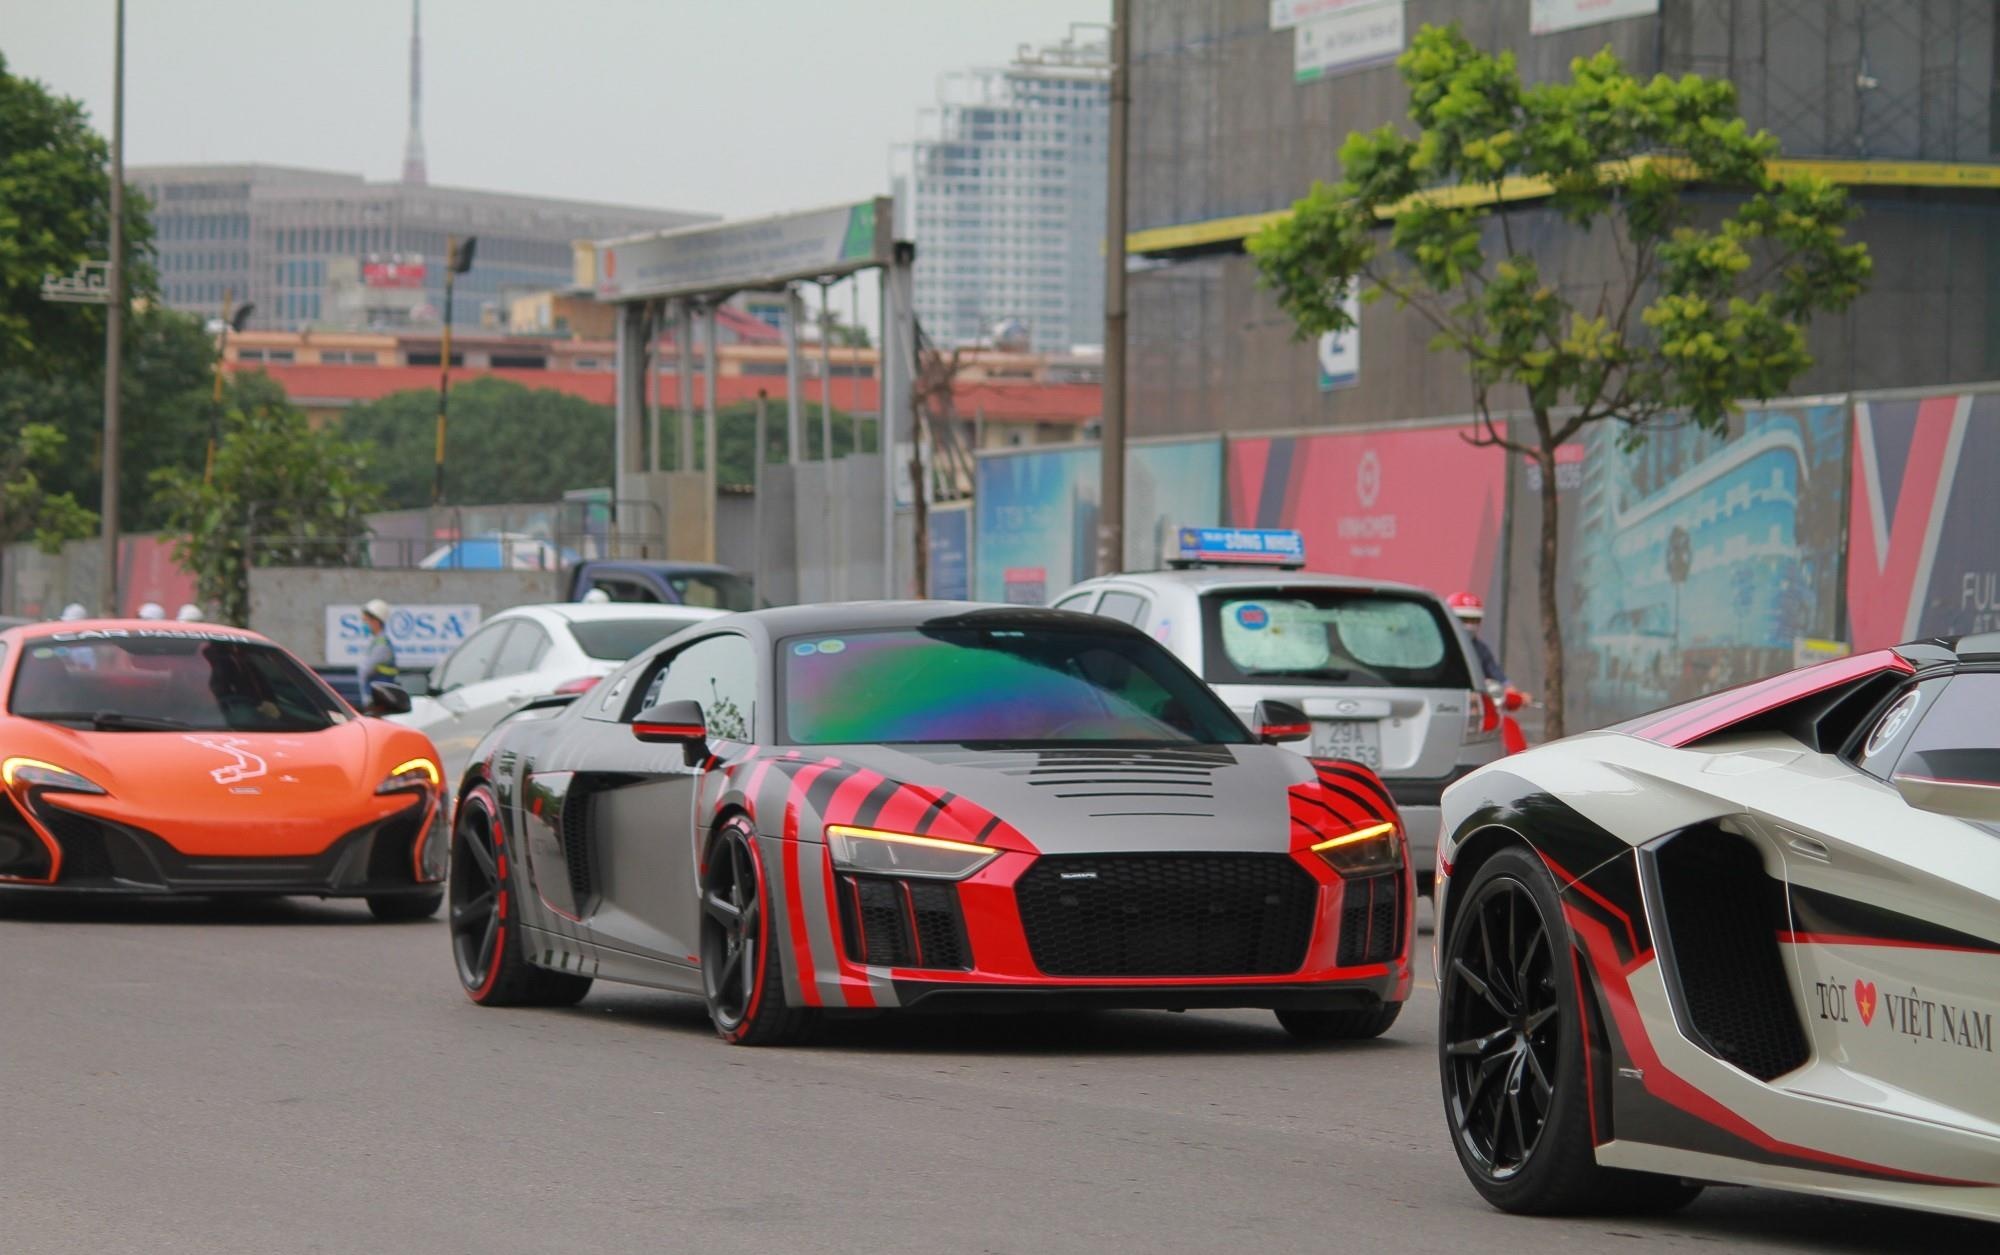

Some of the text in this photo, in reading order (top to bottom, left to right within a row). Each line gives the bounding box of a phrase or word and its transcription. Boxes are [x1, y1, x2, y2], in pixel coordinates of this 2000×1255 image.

[52, 629, 249, 643] CAR PASSION
[1329, 719, 1364, 744] 29A
[1816, 976, 1992, 1052] TÔI VIỆT NAM
